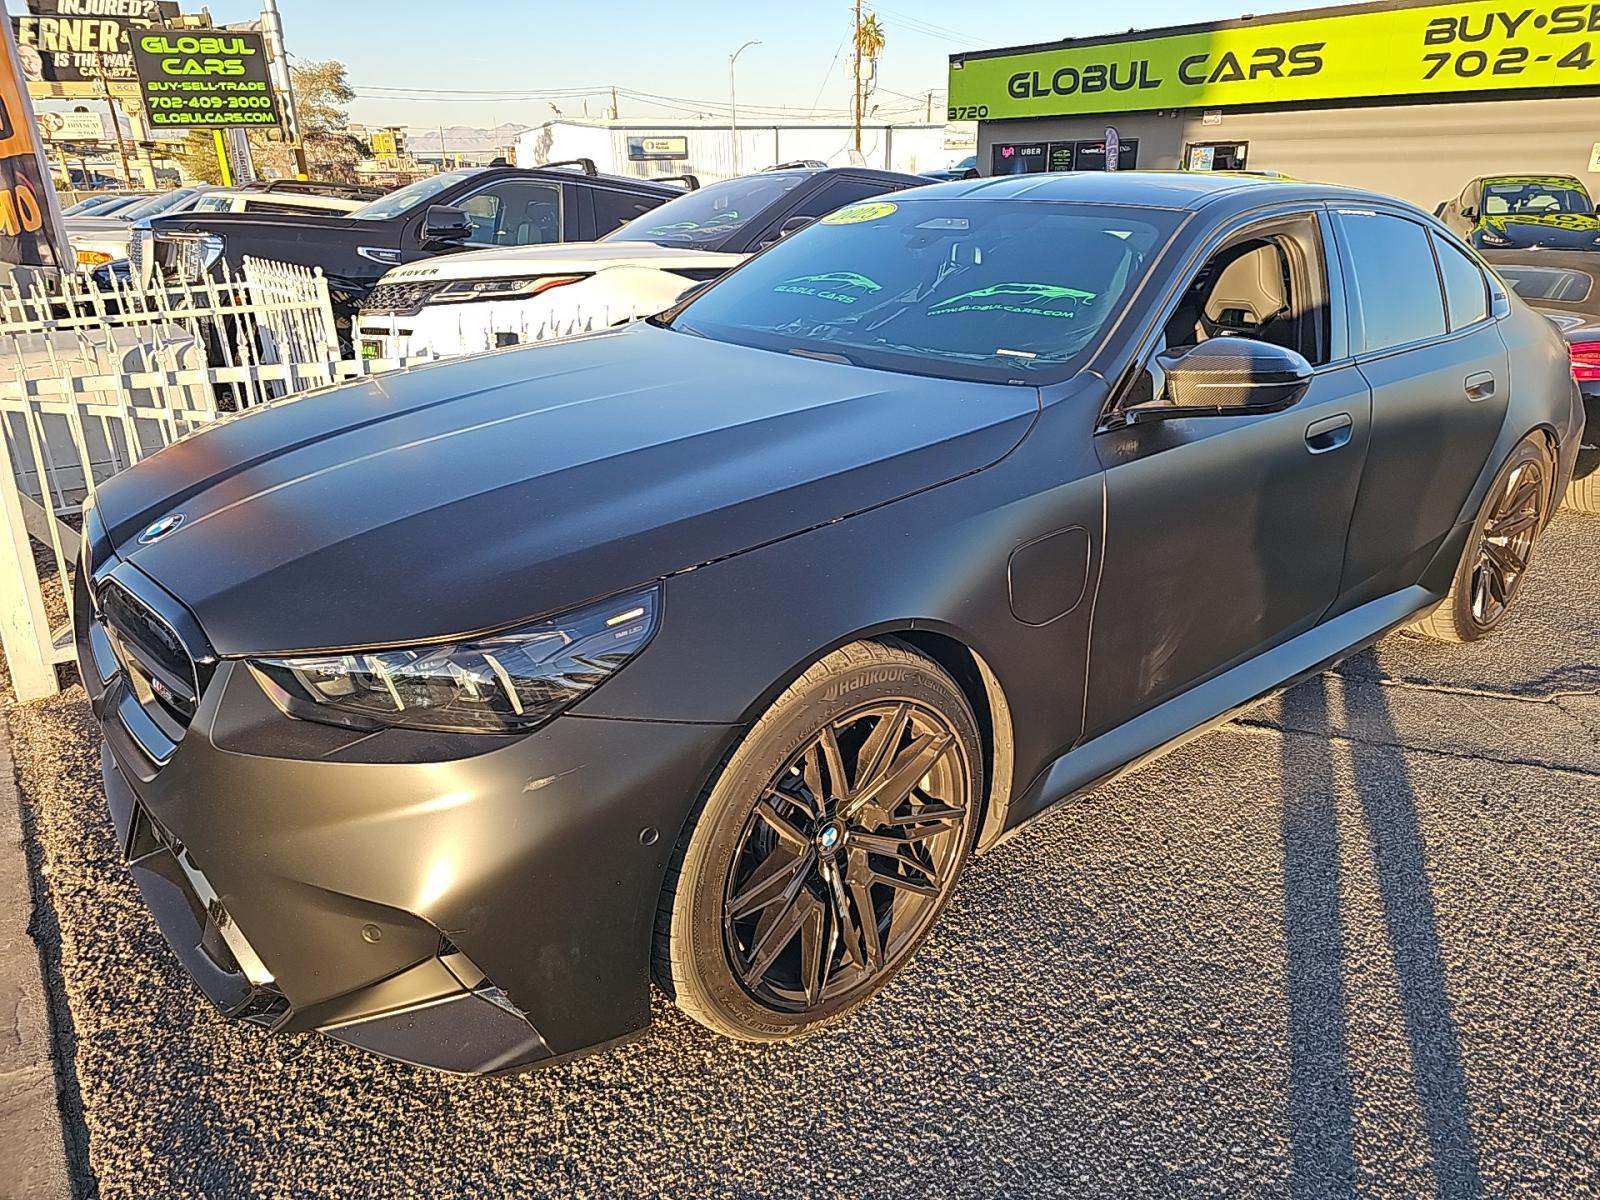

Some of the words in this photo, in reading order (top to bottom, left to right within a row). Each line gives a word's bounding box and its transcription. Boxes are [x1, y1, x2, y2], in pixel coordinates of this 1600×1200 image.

[57, 0, 155, 17] INJURED?
[141, 36, 256, 55] GLOBUL
[54, 52, 70, 67] IS
[162, 58, 246, 76] CARS
[1007, 60, 1163, 98] GLOBUL
[1178, 42, 1326, 86] CARS
[148, 96, 271, 109] 702-409-3000
[152, 112, 276, 124] GLOBULCARS.COM
[947, 105, 988, 120] 3720
[1021, 147, 1041, 156] UBER
[816, 290, 858, 304] CARS
